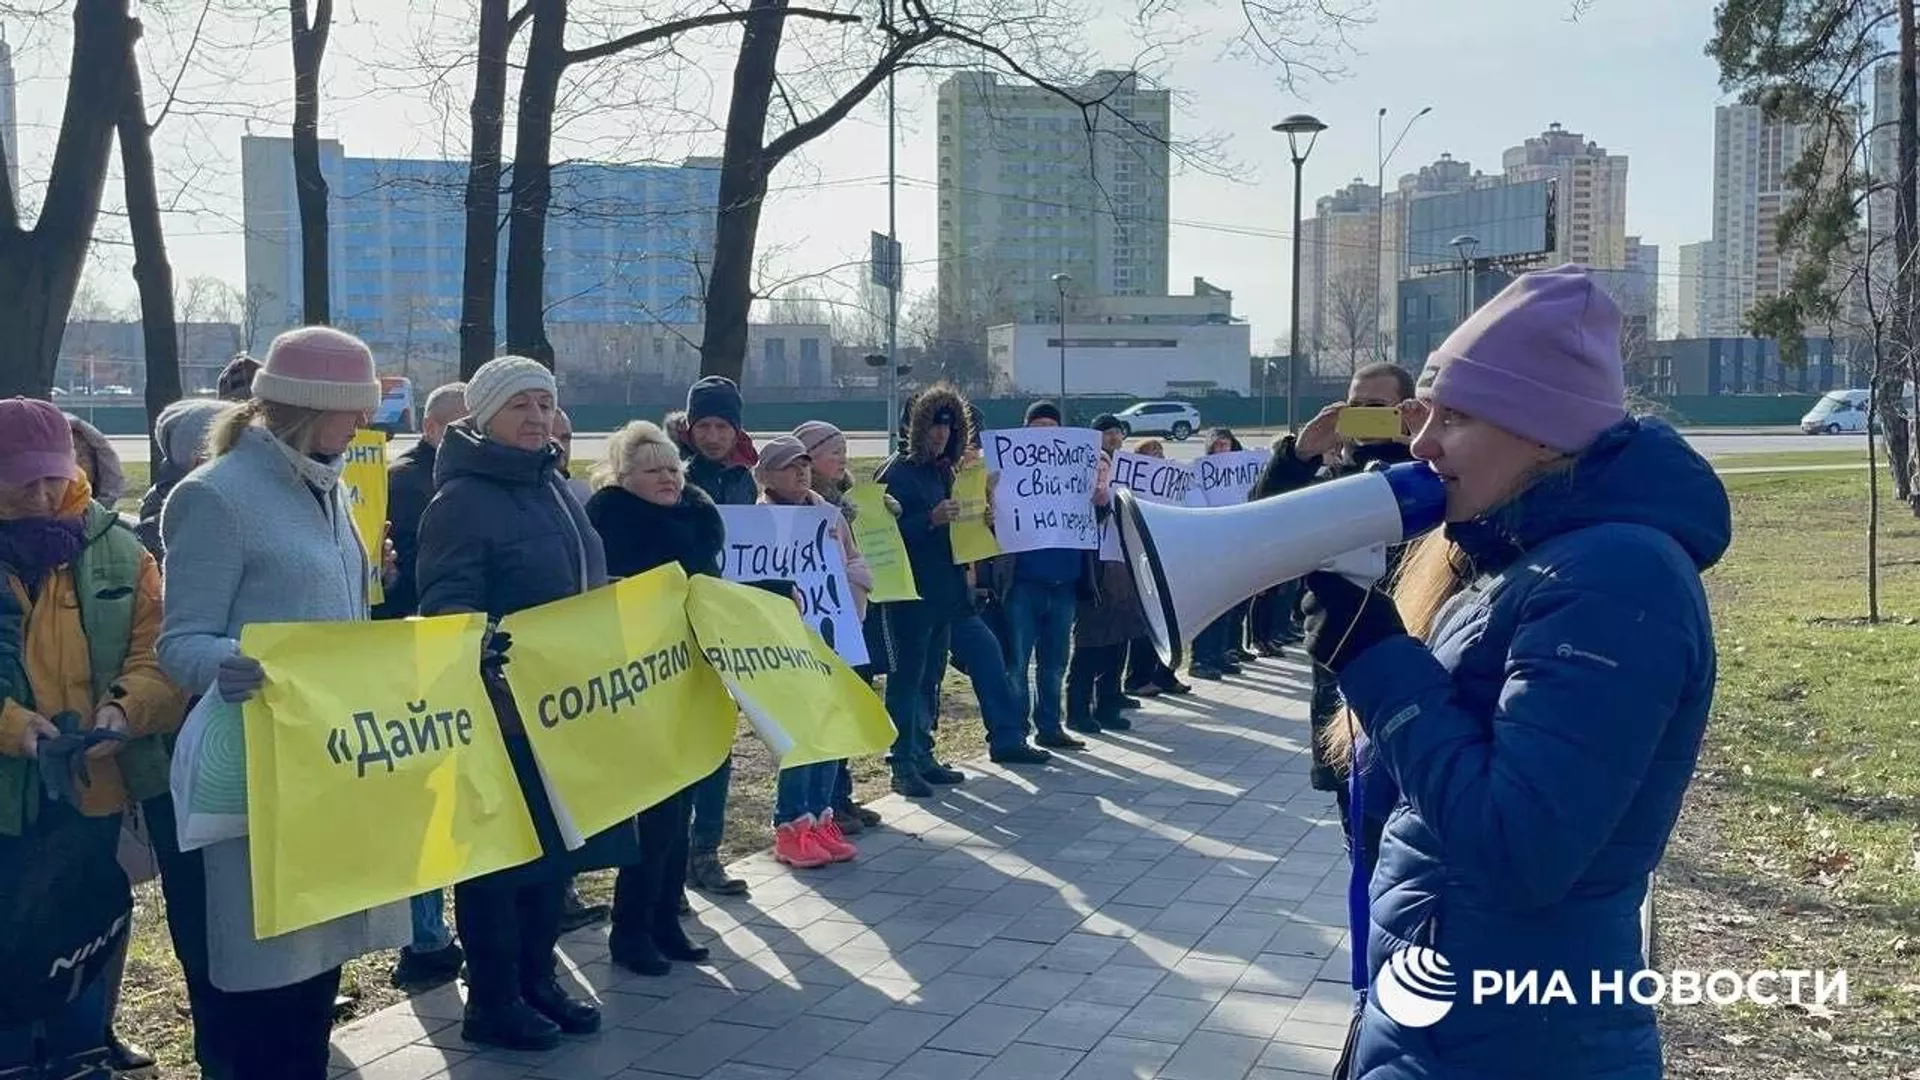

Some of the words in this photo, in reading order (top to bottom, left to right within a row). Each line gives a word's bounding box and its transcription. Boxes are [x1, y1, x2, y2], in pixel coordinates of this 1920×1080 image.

[1109, 457, 1150, 493] ДЕ
[326, 699, 473, 778] «Дайте
[537, 640, 692, 729] солдатам
